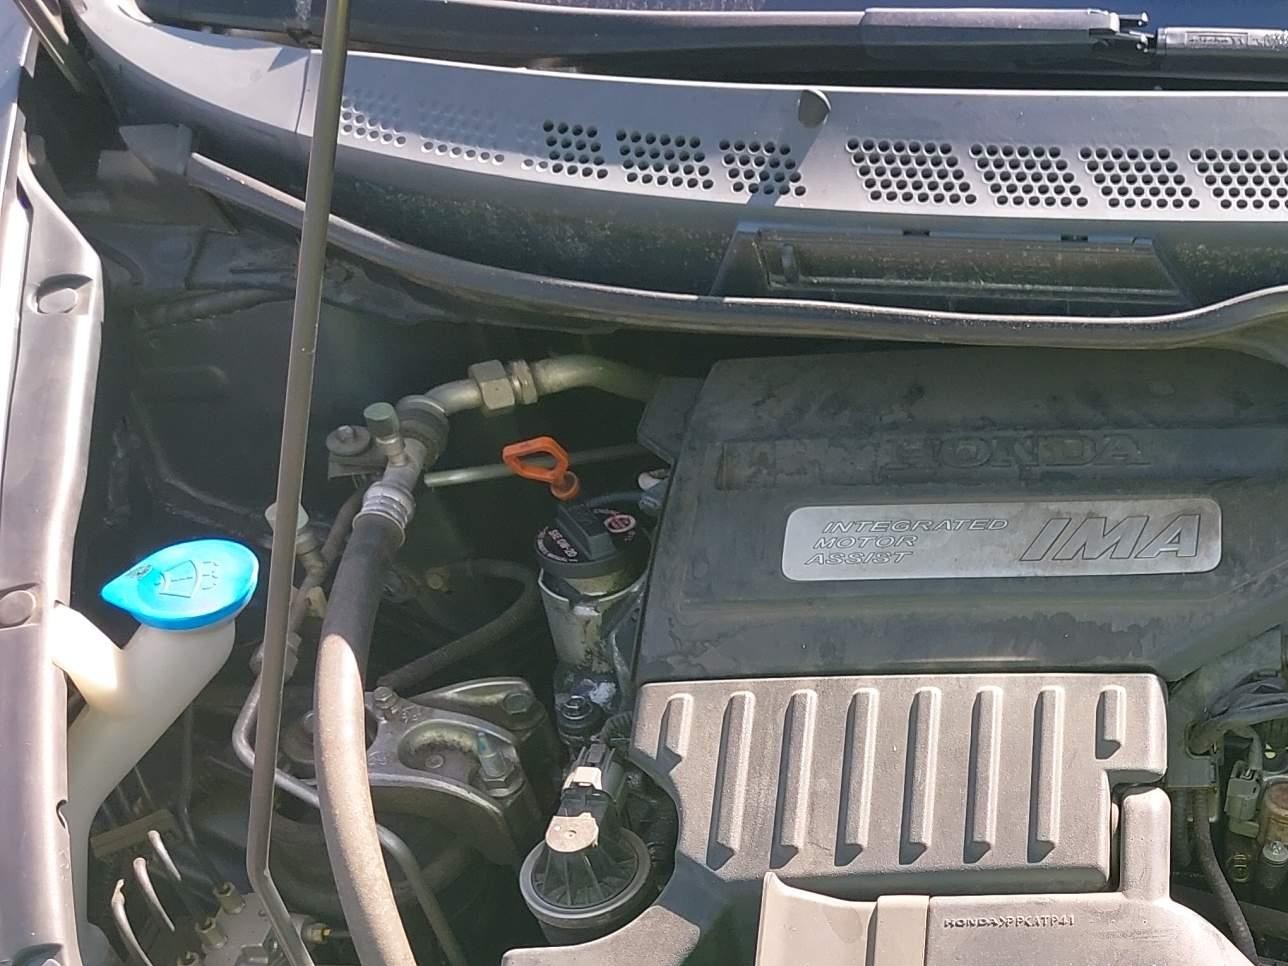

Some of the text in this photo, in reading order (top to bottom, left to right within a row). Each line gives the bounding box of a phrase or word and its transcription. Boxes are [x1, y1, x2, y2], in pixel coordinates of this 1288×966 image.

[884, 433, 1151, 470] HONDA
[823, 518, 1009, 532] INTEGRATED
[813, 535, 918, 549] MOTOR
[1019, 513, 1200, 562] IMA
[804, 551, 914, 566] ASSIST
